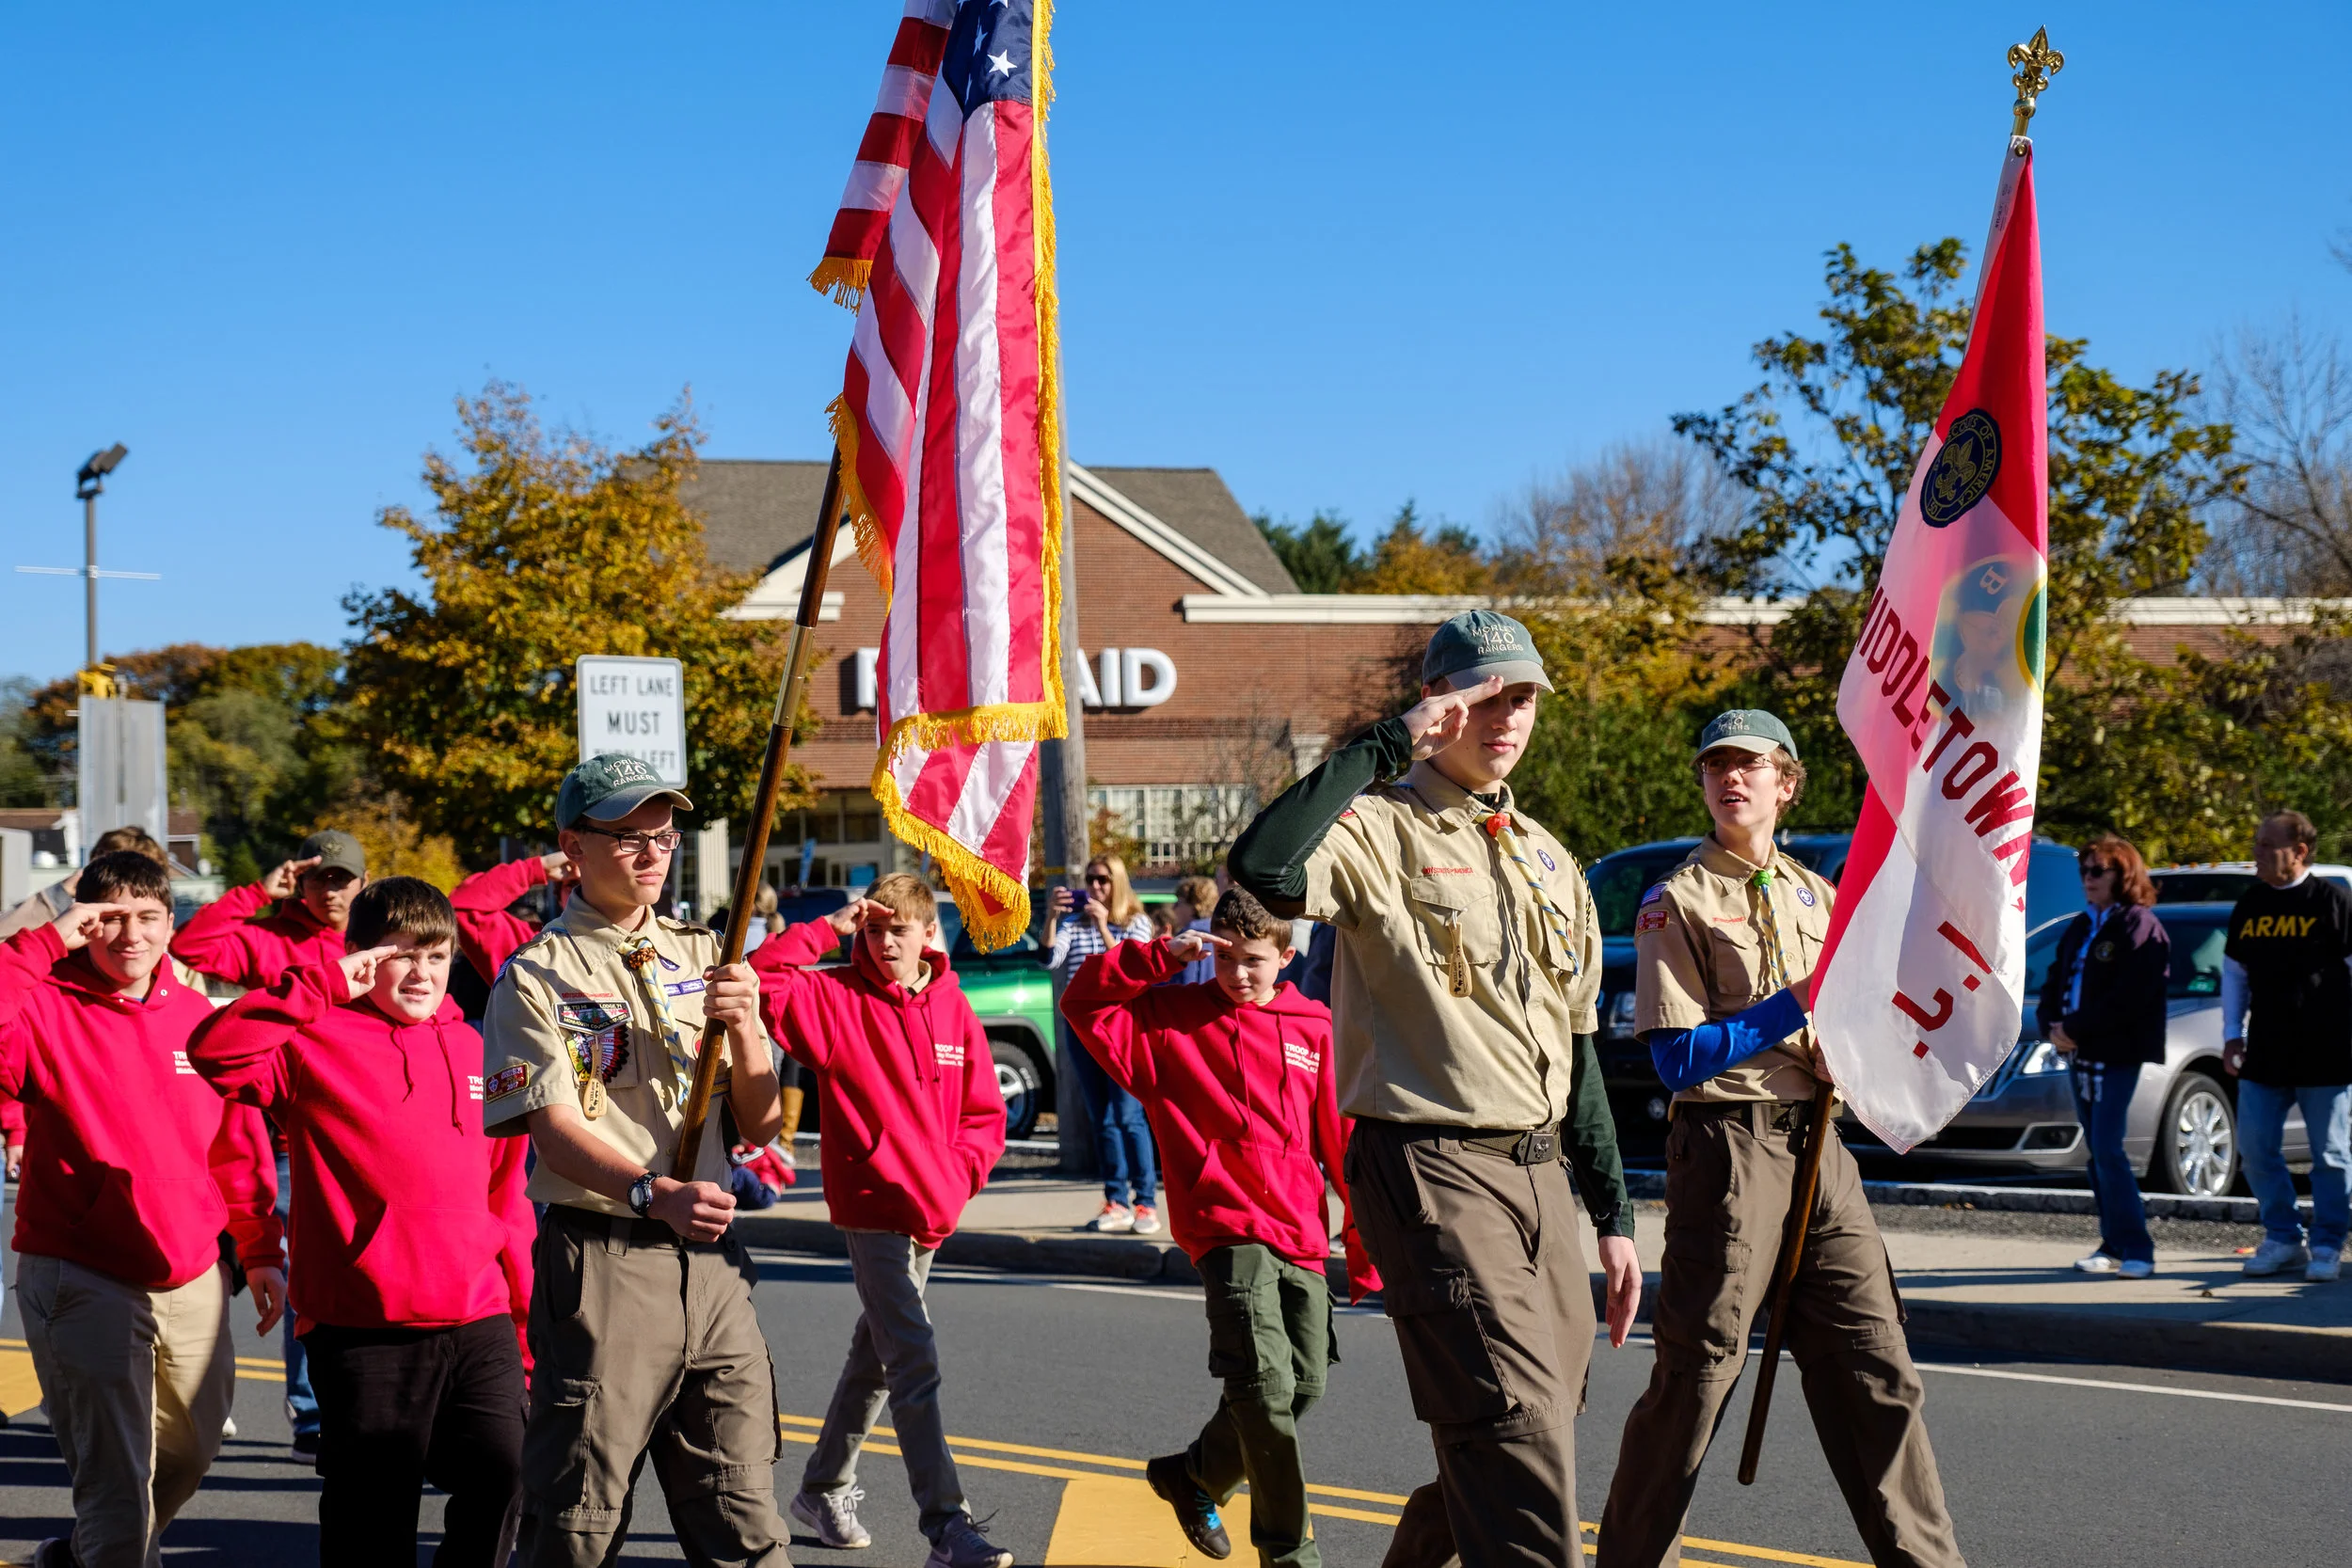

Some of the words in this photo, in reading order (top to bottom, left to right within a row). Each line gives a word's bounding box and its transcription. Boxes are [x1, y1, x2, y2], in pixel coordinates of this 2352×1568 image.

[1957, 449, 1994, 506] AMERICA
[1483, 631, 1514, 645] 140
[1478, 643, 1523, 655] RANGERS
[590, 675, 628, 695] LEFT
[637, 677, 674, 697] LANE
[607, 711, 660, 735] MUST
[614, 765, 647, 778] 140
[613, 774, 657, 787] RANGERS
[2240, 914, 2317, 939] ARMY
[1284, 1043, 1309, 1056] TROOP
